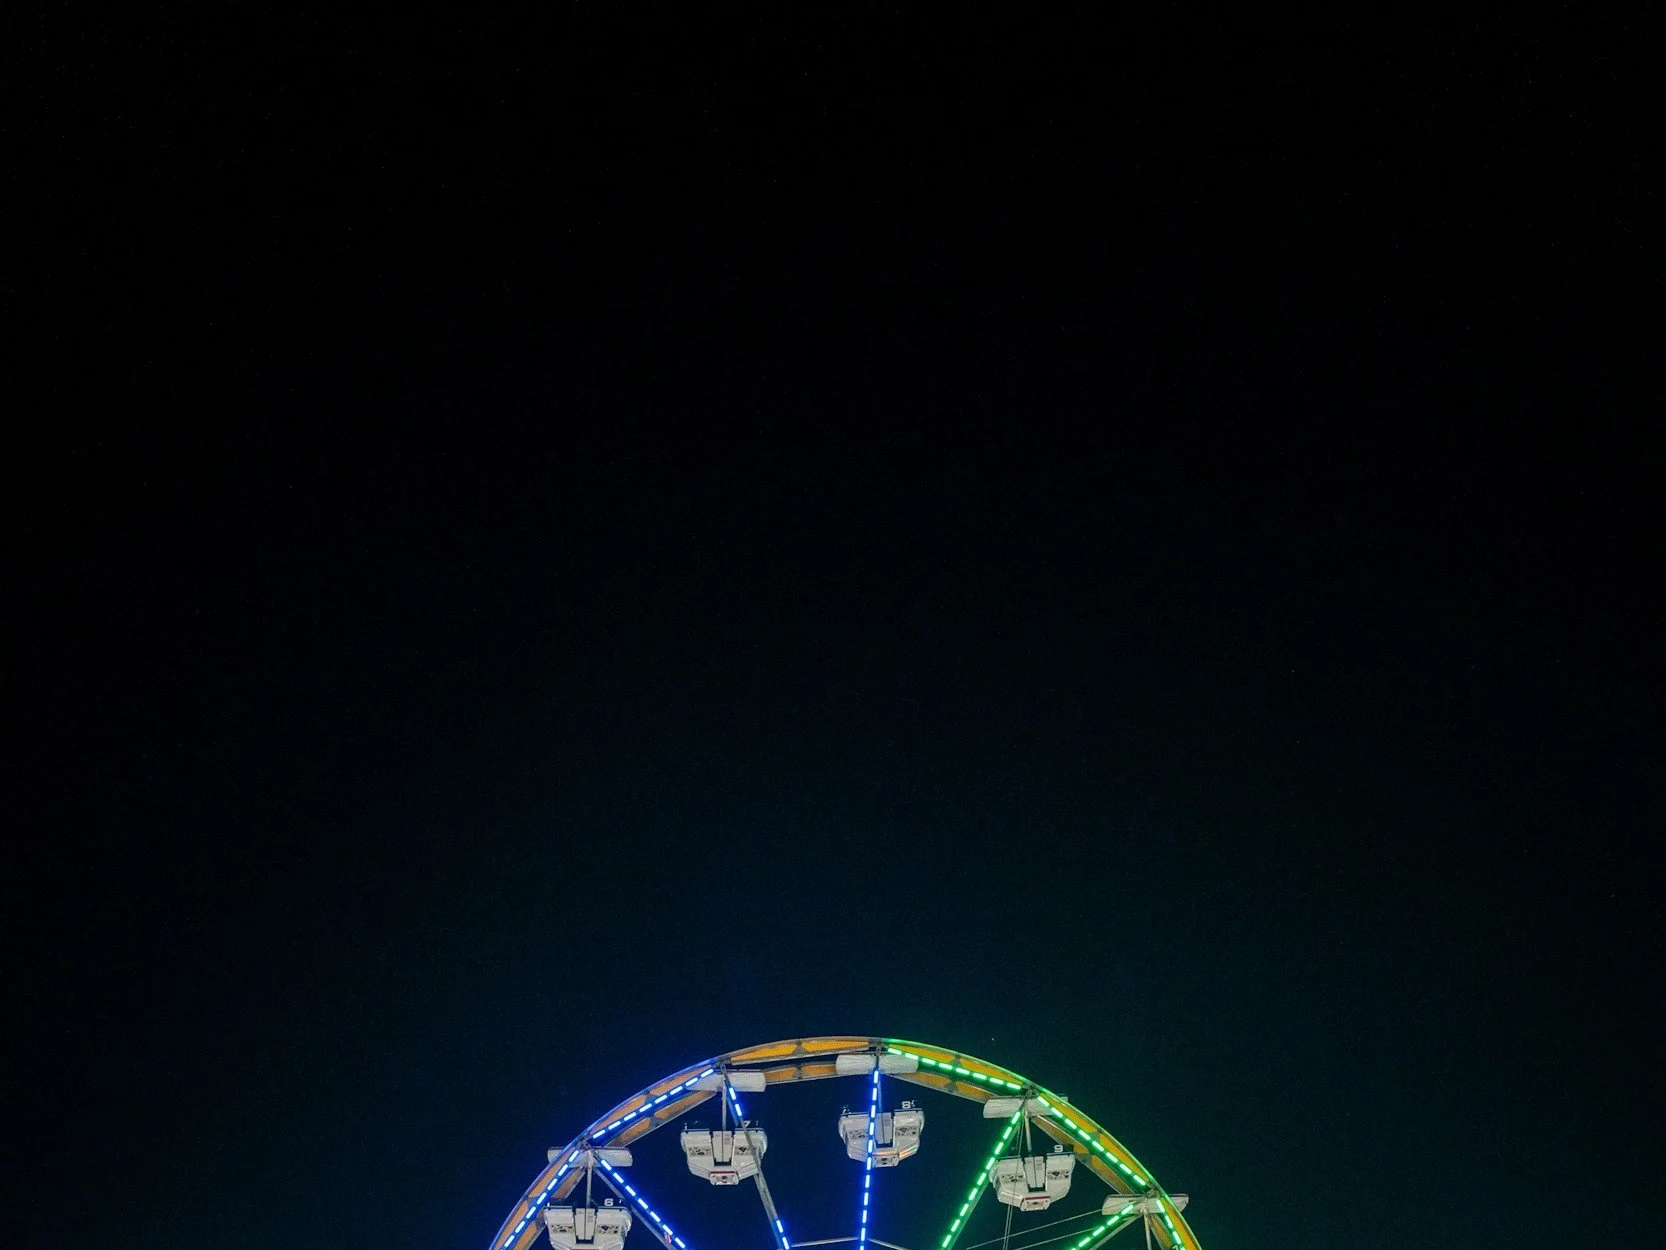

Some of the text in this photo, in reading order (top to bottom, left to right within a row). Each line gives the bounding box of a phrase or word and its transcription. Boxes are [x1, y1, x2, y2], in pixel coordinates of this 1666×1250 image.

[901, 1100, 911, 1109] 8
[1053, 1144, 1063, 1153] 9
[604, 1198, 613, 1206] 6
